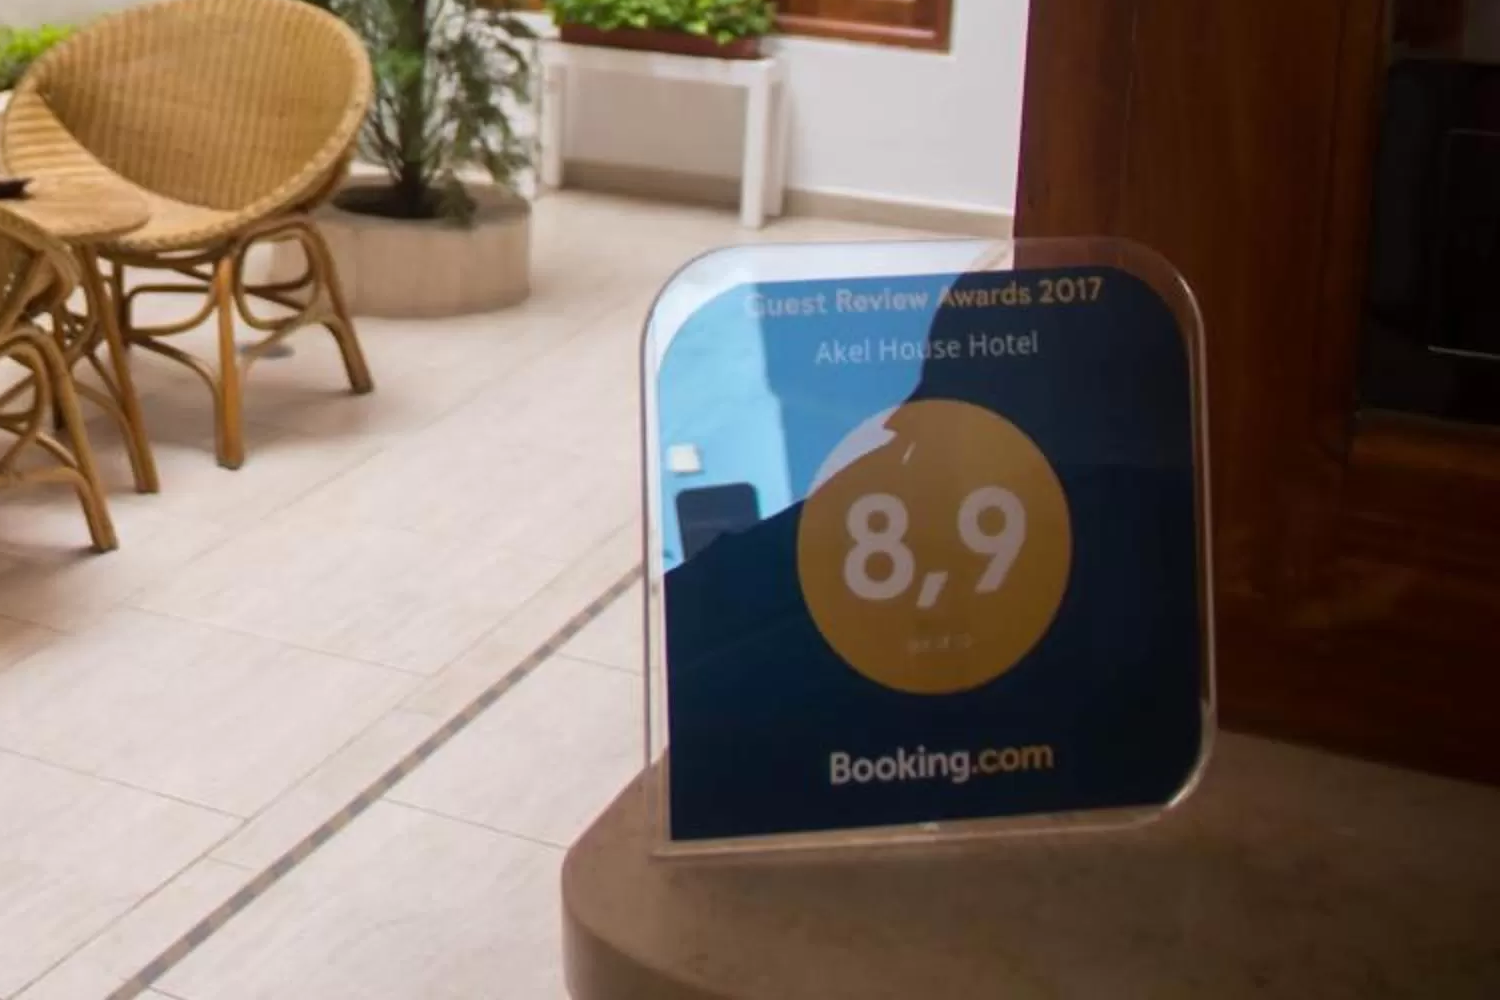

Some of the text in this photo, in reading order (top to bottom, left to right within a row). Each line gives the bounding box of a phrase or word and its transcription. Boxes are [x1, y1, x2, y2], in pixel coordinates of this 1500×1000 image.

[744, 276, 1104, 318] Guest Review Awards 2017
[814, 330, 1038, 365] Akel House Hotel
[843, 485, 1027, 609] 8,9
[830, 744, 1055, 785] Booking.com
